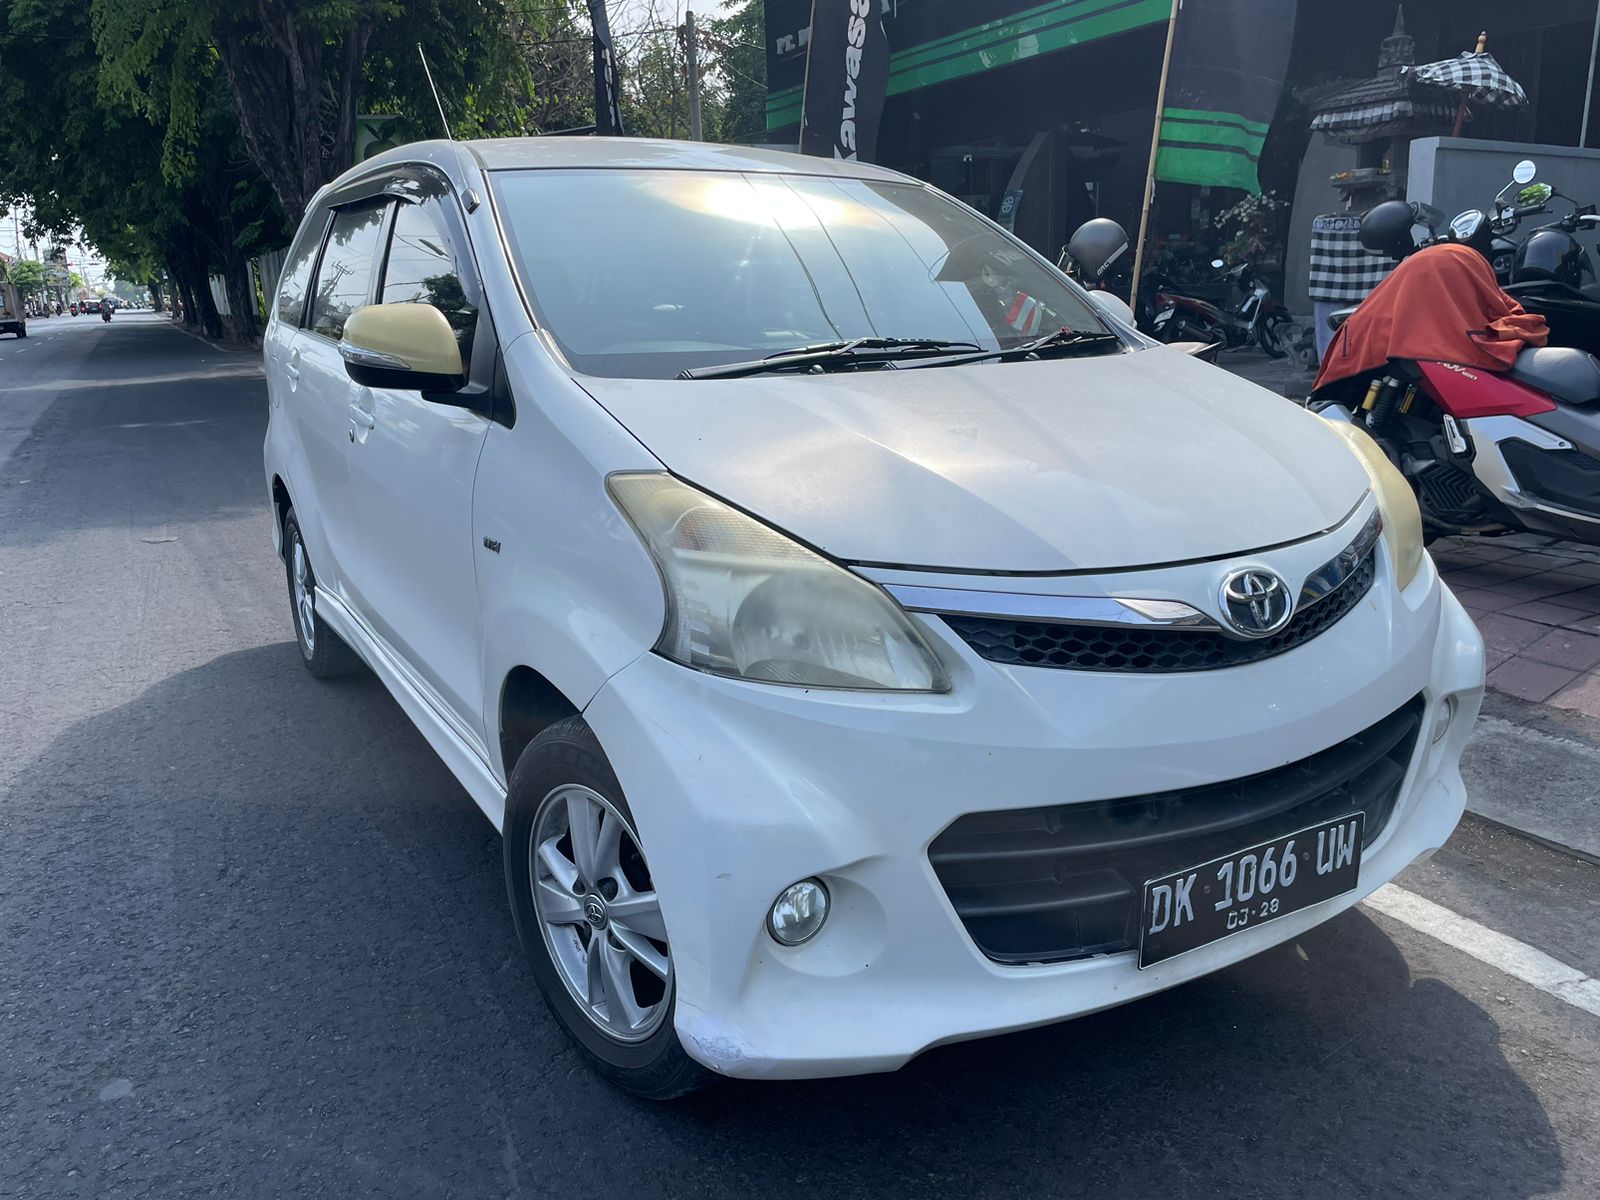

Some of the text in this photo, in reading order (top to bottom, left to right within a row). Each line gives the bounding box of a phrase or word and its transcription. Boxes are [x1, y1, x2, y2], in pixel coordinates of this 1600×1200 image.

[1149, 820, 1357, 936] DK 1066 UW
